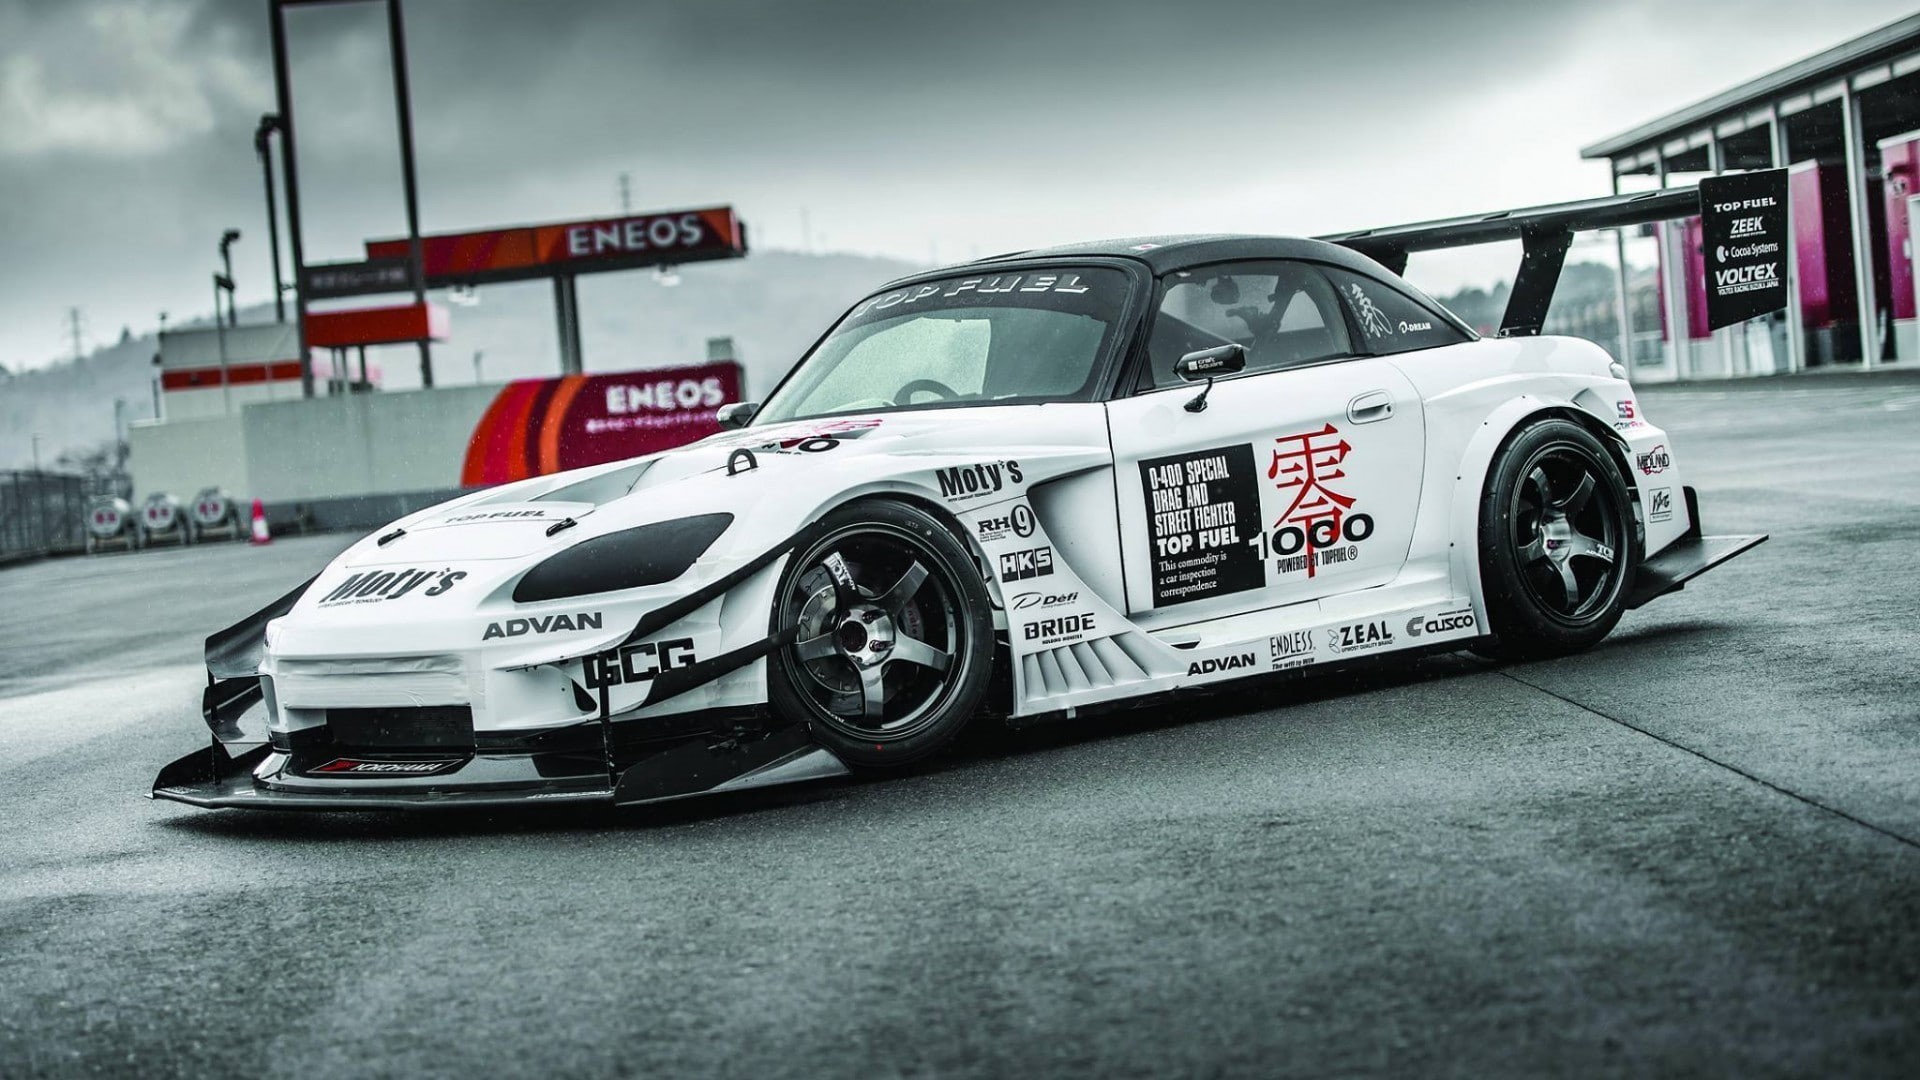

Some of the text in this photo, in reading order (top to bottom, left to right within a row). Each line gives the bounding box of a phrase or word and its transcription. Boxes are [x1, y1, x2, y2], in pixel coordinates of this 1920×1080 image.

[1714, 197, 1777, 213] TOP FUEL
[569, 215, 702, 255] ENEOS
[1730, 216, 1763, 234] ZEEK
[1730, 242, 1778, 258] Cocoa Systems
[1715, 262, 1777, 286] VOLTEX
[854, 274, 1089, 318] TOP FUEL
[606, 378, 724, 413] ENEOS
[936, 460, 1023, 497] Moty's
[1186, 456, 1230, 484] SPECIAL
[1152, 483, 1209, 514] DRAG AND
[446, 511, 544, 523] TOP FUEL
[1155, 501, 1236, 537] STREET FIGHTER
[1157, 526, 1239, 556] TOP FUEL
[1000, 547, 1053, 580] HKS
[1159, 551, 1227, 572] This commodity is
[1277, 555, 1307, 574] POWERED
[318, 567, 468, 604] Moty's
[1160, 580, 1217, 597] correspondence
[1166, 575, 1177, 584] car
[1179, 567, 1217, 582] inspection
[482, 612, 602, 641] ADVAN
[1024, 613, 1096, 640] BRIDE
[1340, 621, 1392, 646] ZEAL
[1269, 630, 1313, 656] ENDLESS
[582, 638, 696, 689] GCG
[1187, 653, 1256, 677] ADVAN
